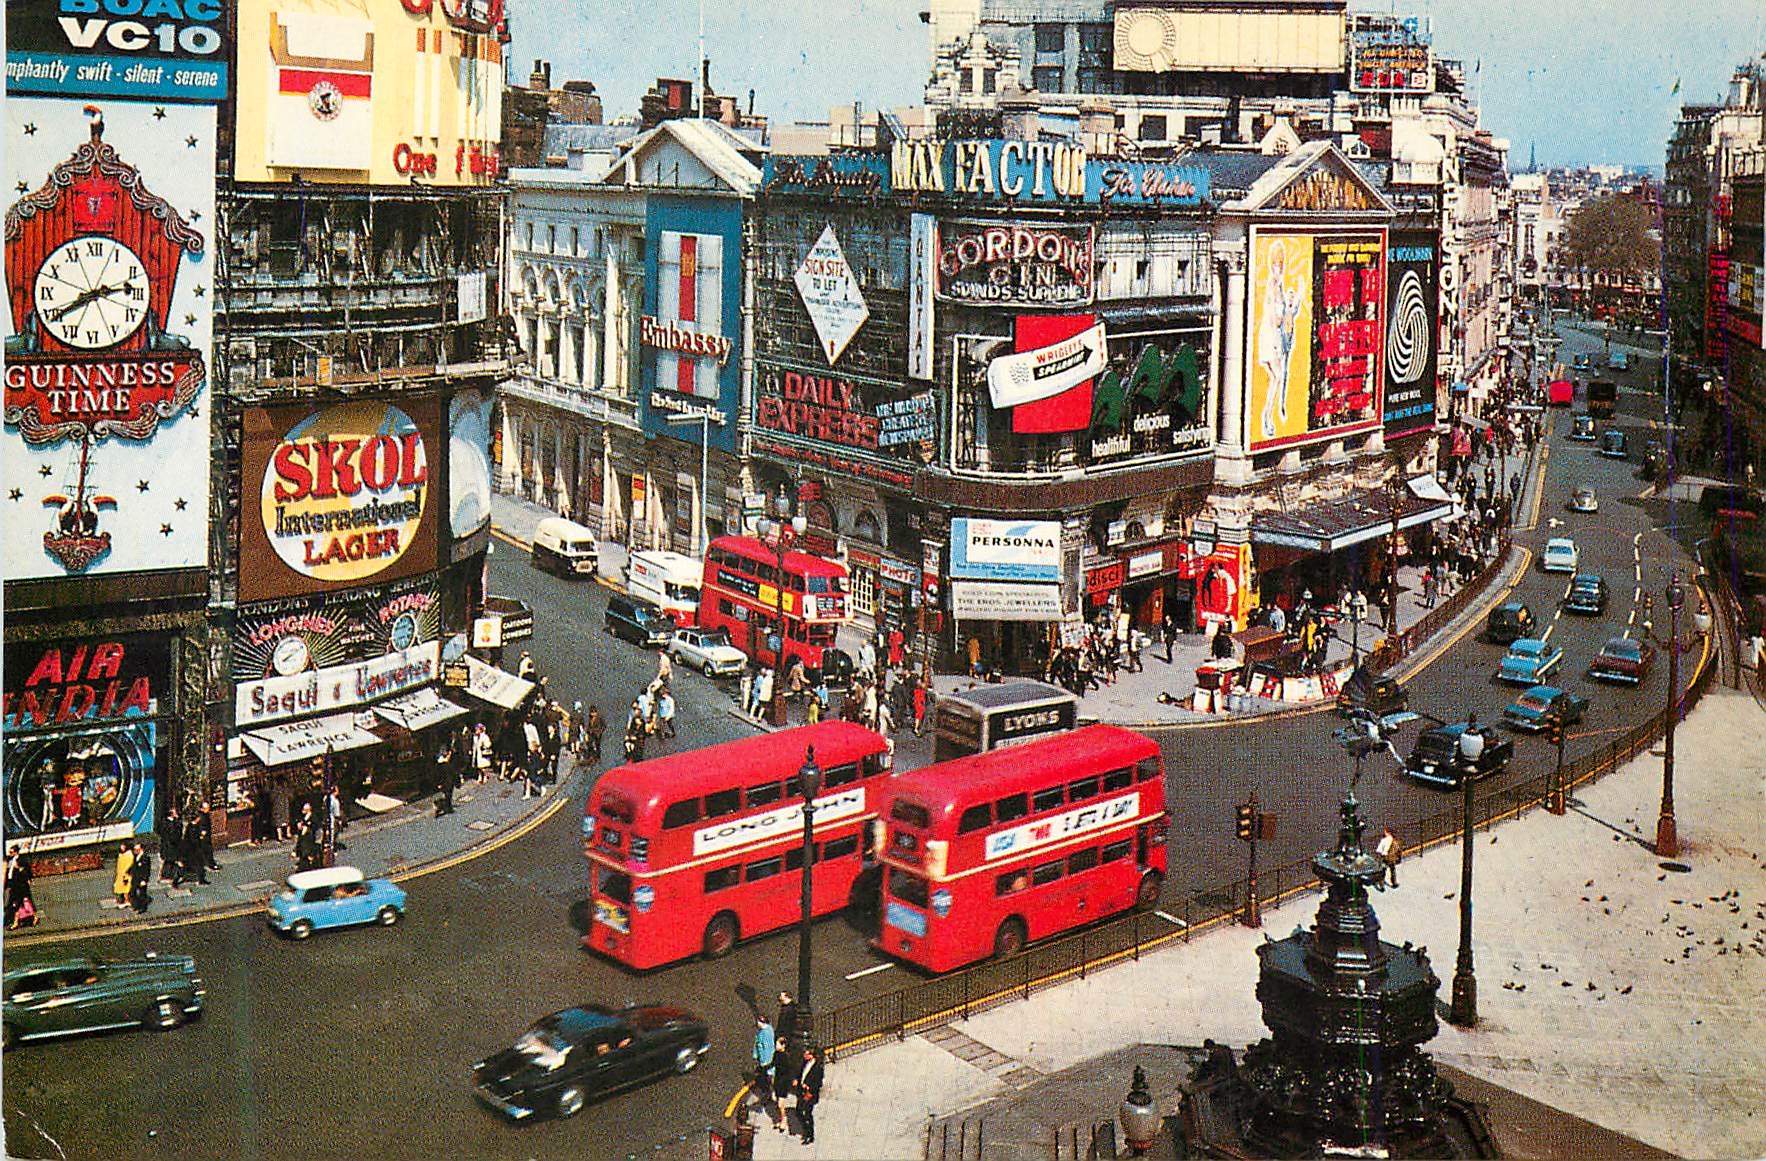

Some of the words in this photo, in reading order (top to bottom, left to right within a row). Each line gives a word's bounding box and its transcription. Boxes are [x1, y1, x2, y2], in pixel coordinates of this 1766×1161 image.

[58, 17, 222, 54] VC10
[77, 61, 113, 82] swift
[124, 63, 163, 84] silent
[174, 70, 218, 87] serene
[891, 139, 944, 192] MAX
[954, 139, 1087, 197] FACTOR
[990, 262, 1057, 286] GIN
[640, 315, 731, 367] Embassy
[5, 362, 175, 388] GUINNESS
[48, 389, 130, 414] TIME
[785, 372, 855, 411] DAILY
[758, 396, 880, 449] EXPRESS
[1134, 413, 1170, 432] delicious
[1092, 434, 1131, 457] healthful
[274, 431, 428, 502] SKOL
[275, 488, 422, 537] International
[303, 528, 401, 567] LAGER
[972, 536, 1054, 548] PERSONNA
[881, 564, 918, 584] PHOTO
[378, 593, 434, 625] ROTARY
[249, 616, 336, 647] LONGINES
[25, 642, 124, 687] AIR
[279, 718, 323, 733] SAQUI
[1003, 710, 1060, 732] LYONS
[277, 731, 352, 753] LAWRENCE
[703, 816, 777, 841] LONG
[787, 793, 859, 820] JHN
